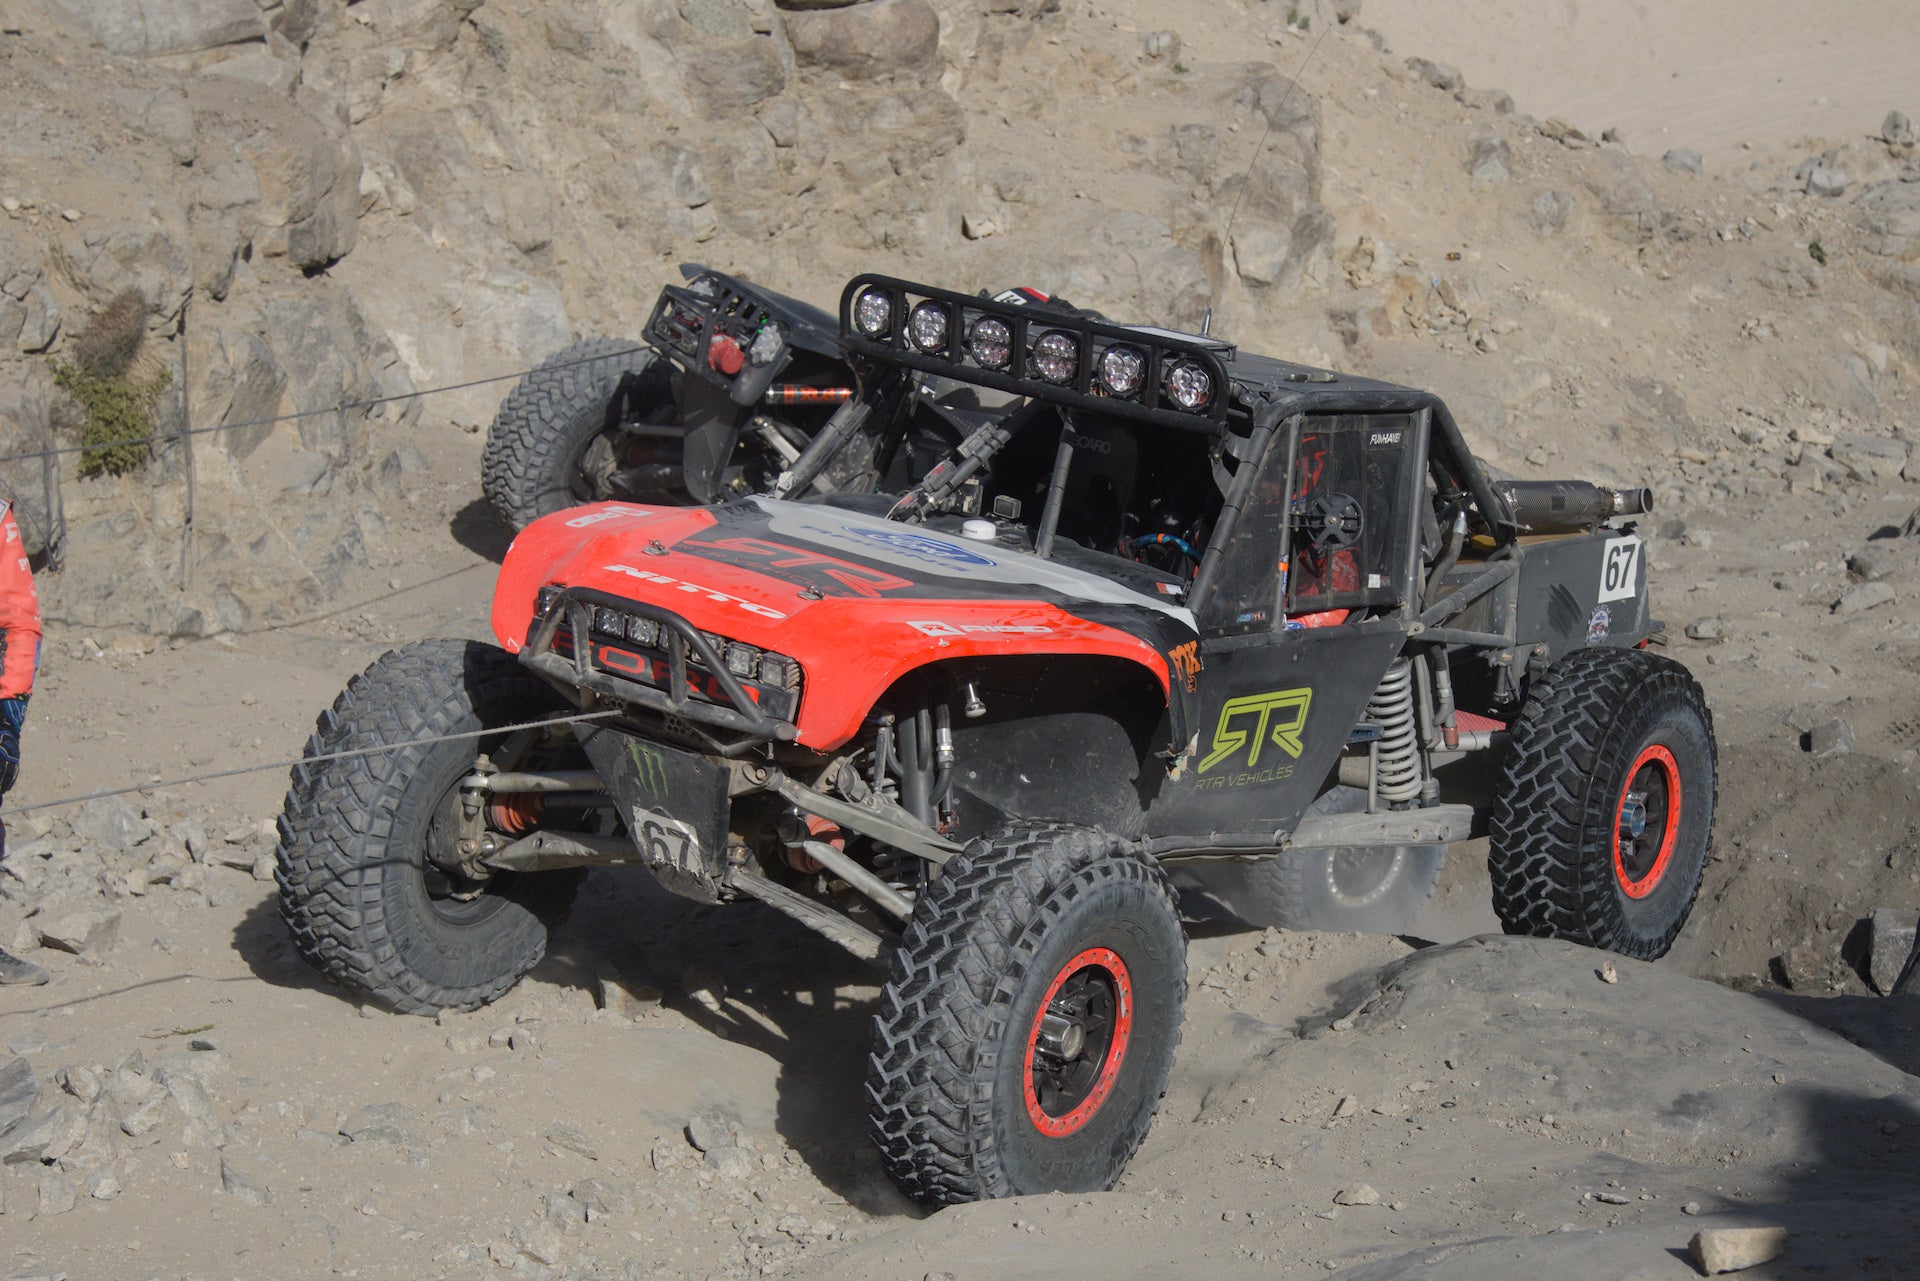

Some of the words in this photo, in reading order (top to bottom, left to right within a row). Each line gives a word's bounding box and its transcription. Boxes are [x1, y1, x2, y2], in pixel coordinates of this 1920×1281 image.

[602, 564, 788, 619] NITTO
[1605, 543, 1637, 592] 67
[552, 630, 760, 705] FORD
[1194, 776, 1225, 792] RTR
[1228, 765, 1295, 787] VEHICLES
[642, 820, 692, 872] 67
